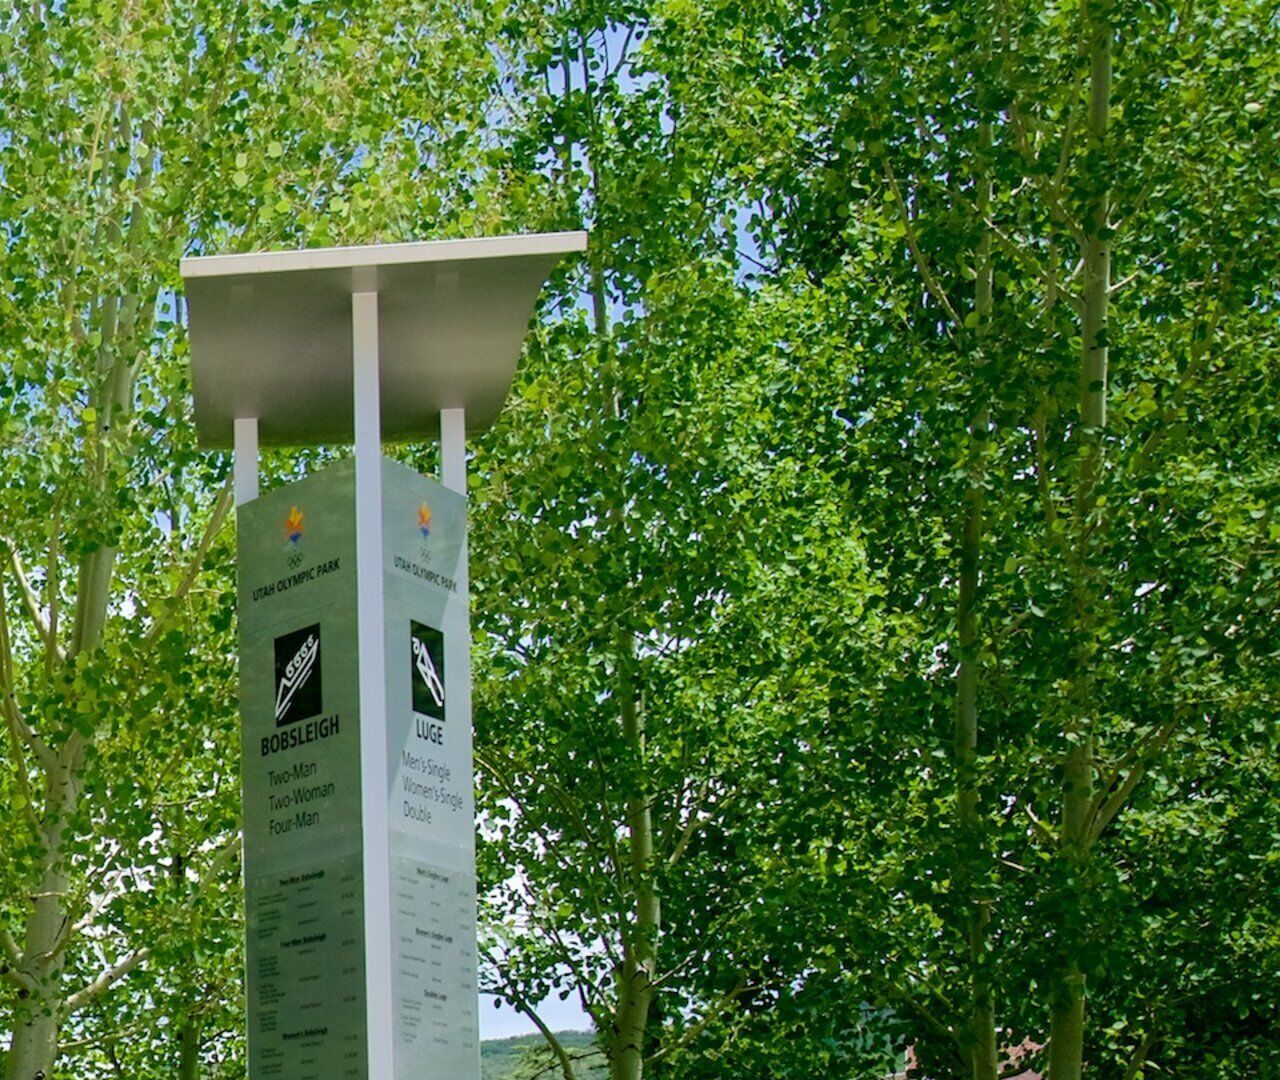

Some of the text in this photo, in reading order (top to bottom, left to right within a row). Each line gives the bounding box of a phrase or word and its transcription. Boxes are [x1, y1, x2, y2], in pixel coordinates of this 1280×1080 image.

[252, 557, 341, 601] UTAH OLYMPIC PARK
[393, 555, 458, 593] UTAH OLYMPIC PARK
[261, 715, 340, 757] BOBSLEIGH
[416, 718, 444, 746] LUGE
[268, 763, 317, 787] Two-Man
[268, 782, 336, 812] Two-Woman
[268, 811, 320, 836] Four-Man
[403, 800, 432, 825] Double
